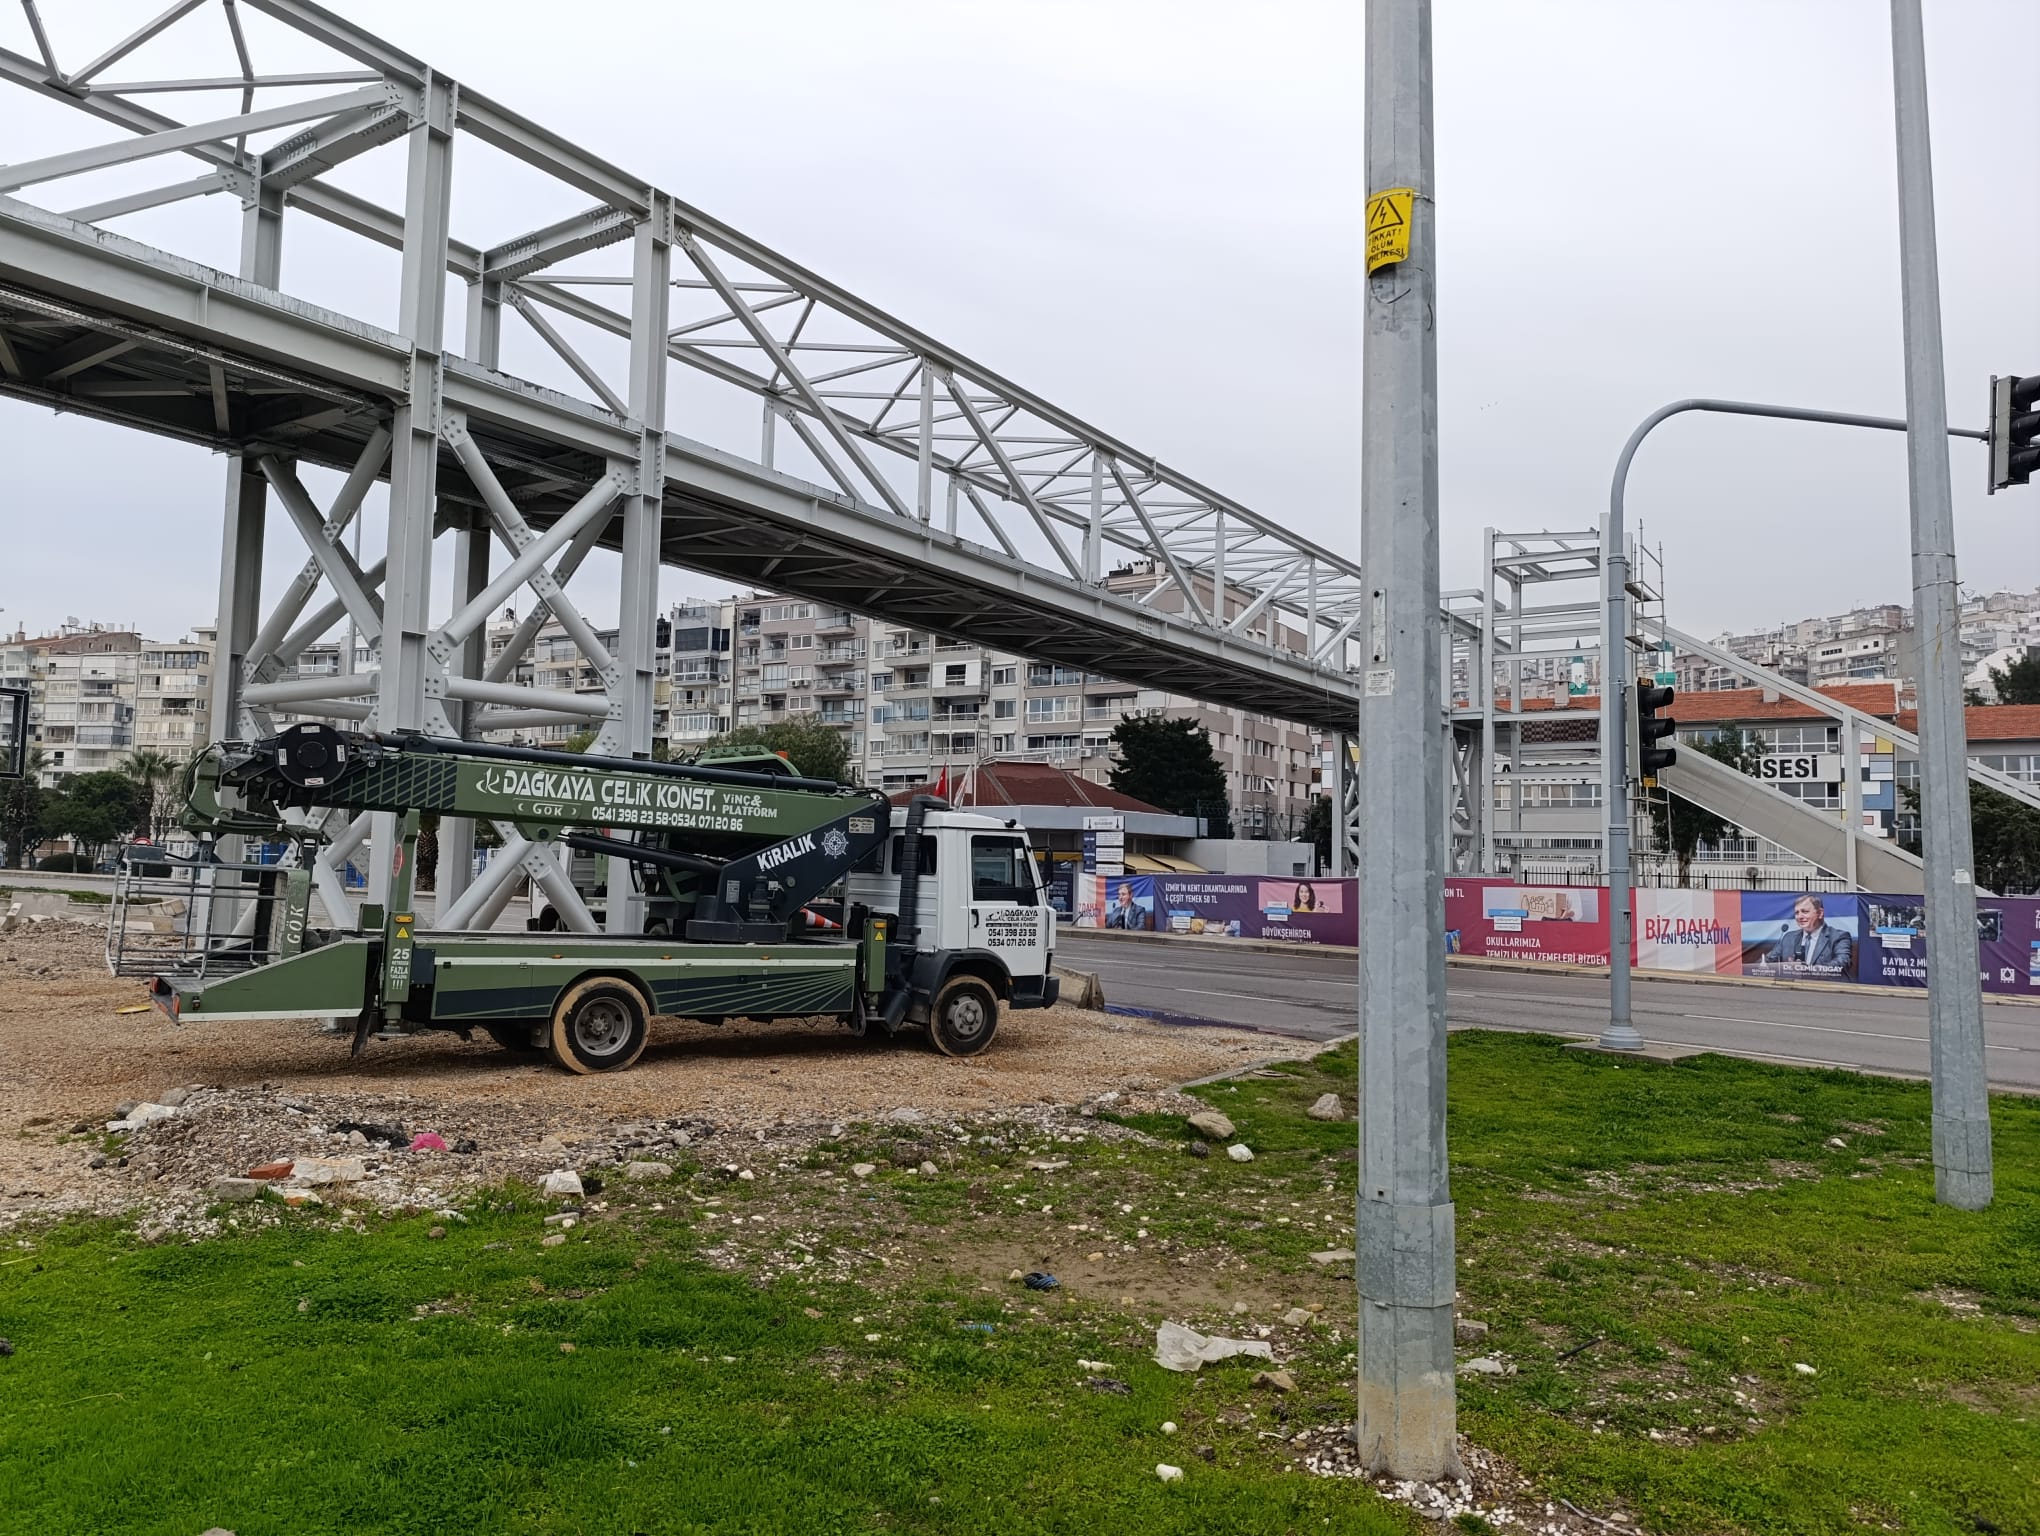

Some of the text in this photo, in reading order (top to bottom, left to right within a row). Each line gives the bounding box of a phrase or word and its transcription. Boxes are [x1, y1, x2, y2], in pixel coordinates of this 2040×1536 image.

[503, 769, 716, 812] DAĞKAYA ÇELİK KONST.
[722, 804, 778, 818] PLATFORM
[617, 808, 638, 823] 398
[640, 811, 653, 824] 23
[730, 818, 743, 831] 86
[756, 833, 817, 871] KİRALIK
[1187, 883, 1201, 893] KENT
[1201, 884, 1248, 894] LOKANTALARINDA
[1455, 888, 1465, 898] TL
[1169, 893, 1184, 904] ÇEŞİT
[1185, 894, 1203, 904] YEMEK
[1203, 895, 1211, 904] 50
[1211, 895, 1218, 904] TL
[286, 903, 305, 944] GÖK
[1645, 914, 1720, 941] BİZ DAHA
[988, 928, 1003, 936] 0541
[1004, 928, 1018, 936] 398
[1018, 928, 1027, 936] 23
[1680, 926, 1731, 948] BAŞLADIK
[988, 938, 1005, 947] 0534
[1006, 938, 1017, 947] 071
[1017, 938, 1027, 947] 20
[1485, 936, 1541, 948] OKULLARIMIZA
[392, 947, 410, 960] 25
[1578, 953, 1607, 965] BİZDEN
[1888, 957, 1909, 967] AYDA
[1910, 958, 1915, 967] 2
[390, 966, 409, 975] FAZLA
[1882, 967, 1927, 978] 650 MİLYON
